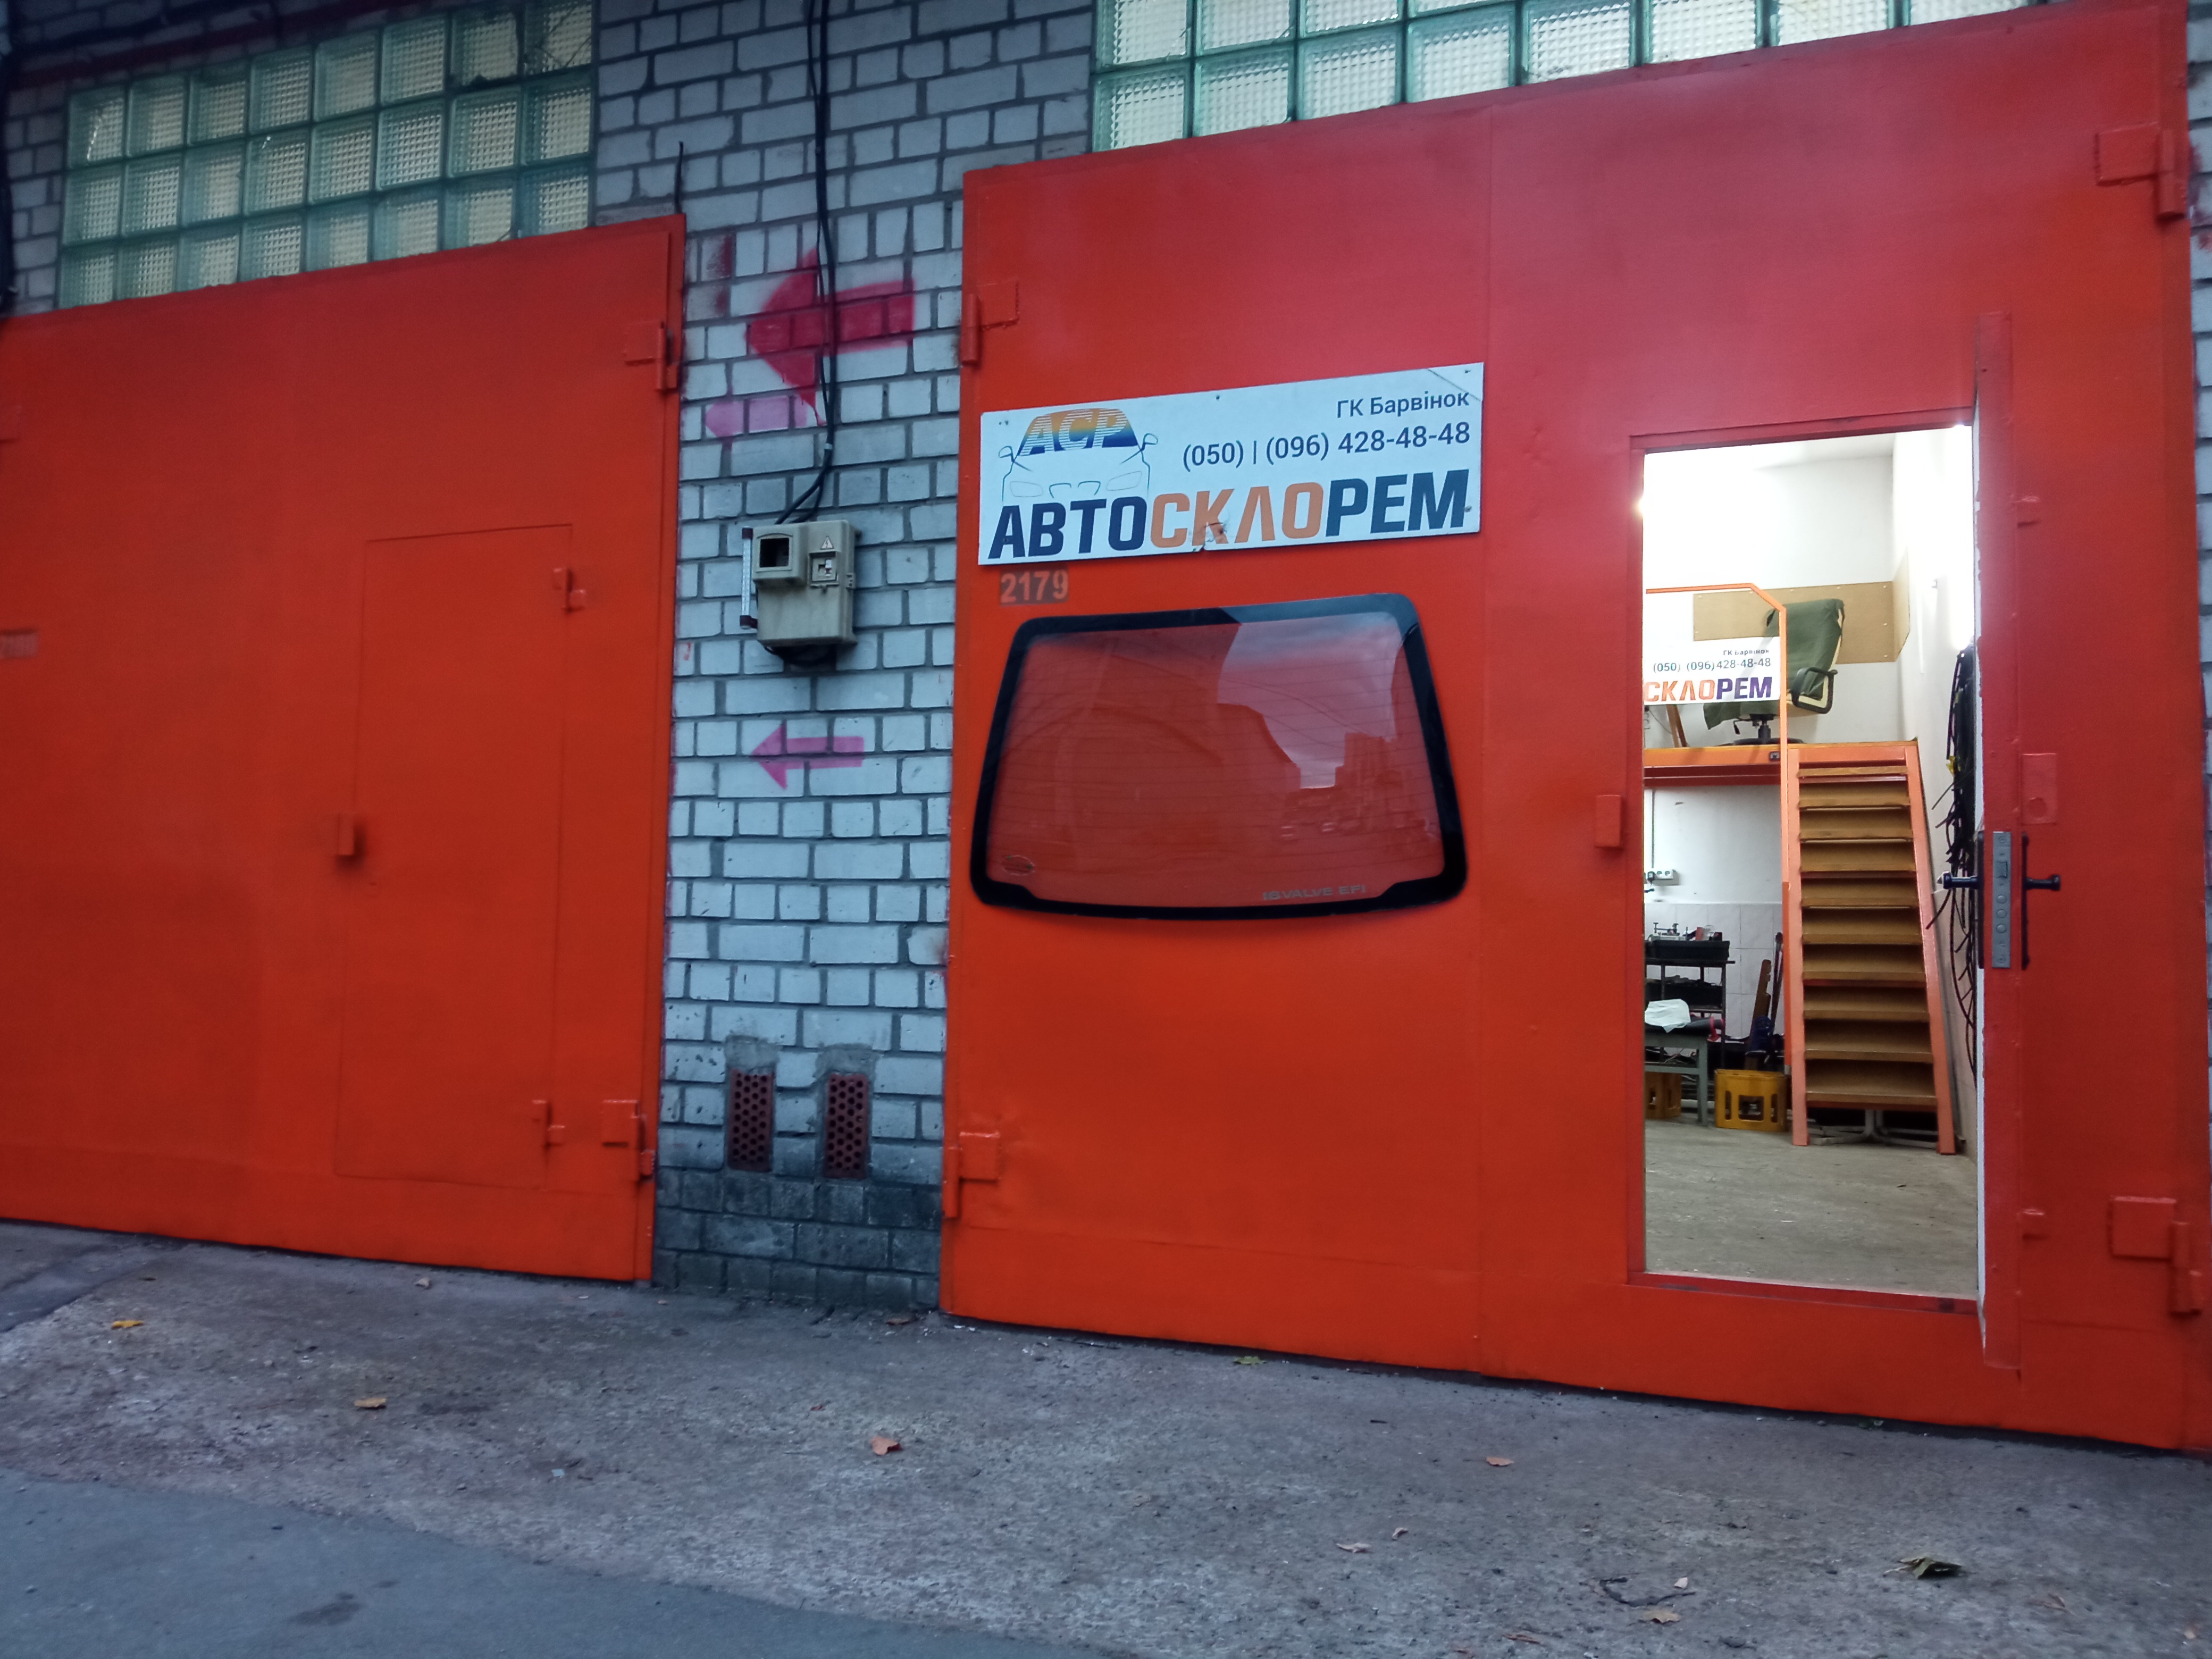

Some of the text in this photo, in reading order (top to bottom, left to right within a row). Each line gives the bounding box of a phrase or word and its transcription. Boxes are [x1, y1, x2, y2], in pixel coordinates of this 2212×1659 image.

[1337, 391, 1469, 418] ГК Барвінок
[1183, 440, 1244, 472] (050)
[1266, 432, 1329, 465] (096)
[1338, 422, 1470, 454] 428-48-48
[988, 469, 1469, 559] АВТОСКЛОРЕМ
[1001, 570, 1069, 603] 2179
[1653, 658, 1771, 673] (050) (096) 428-48-48
